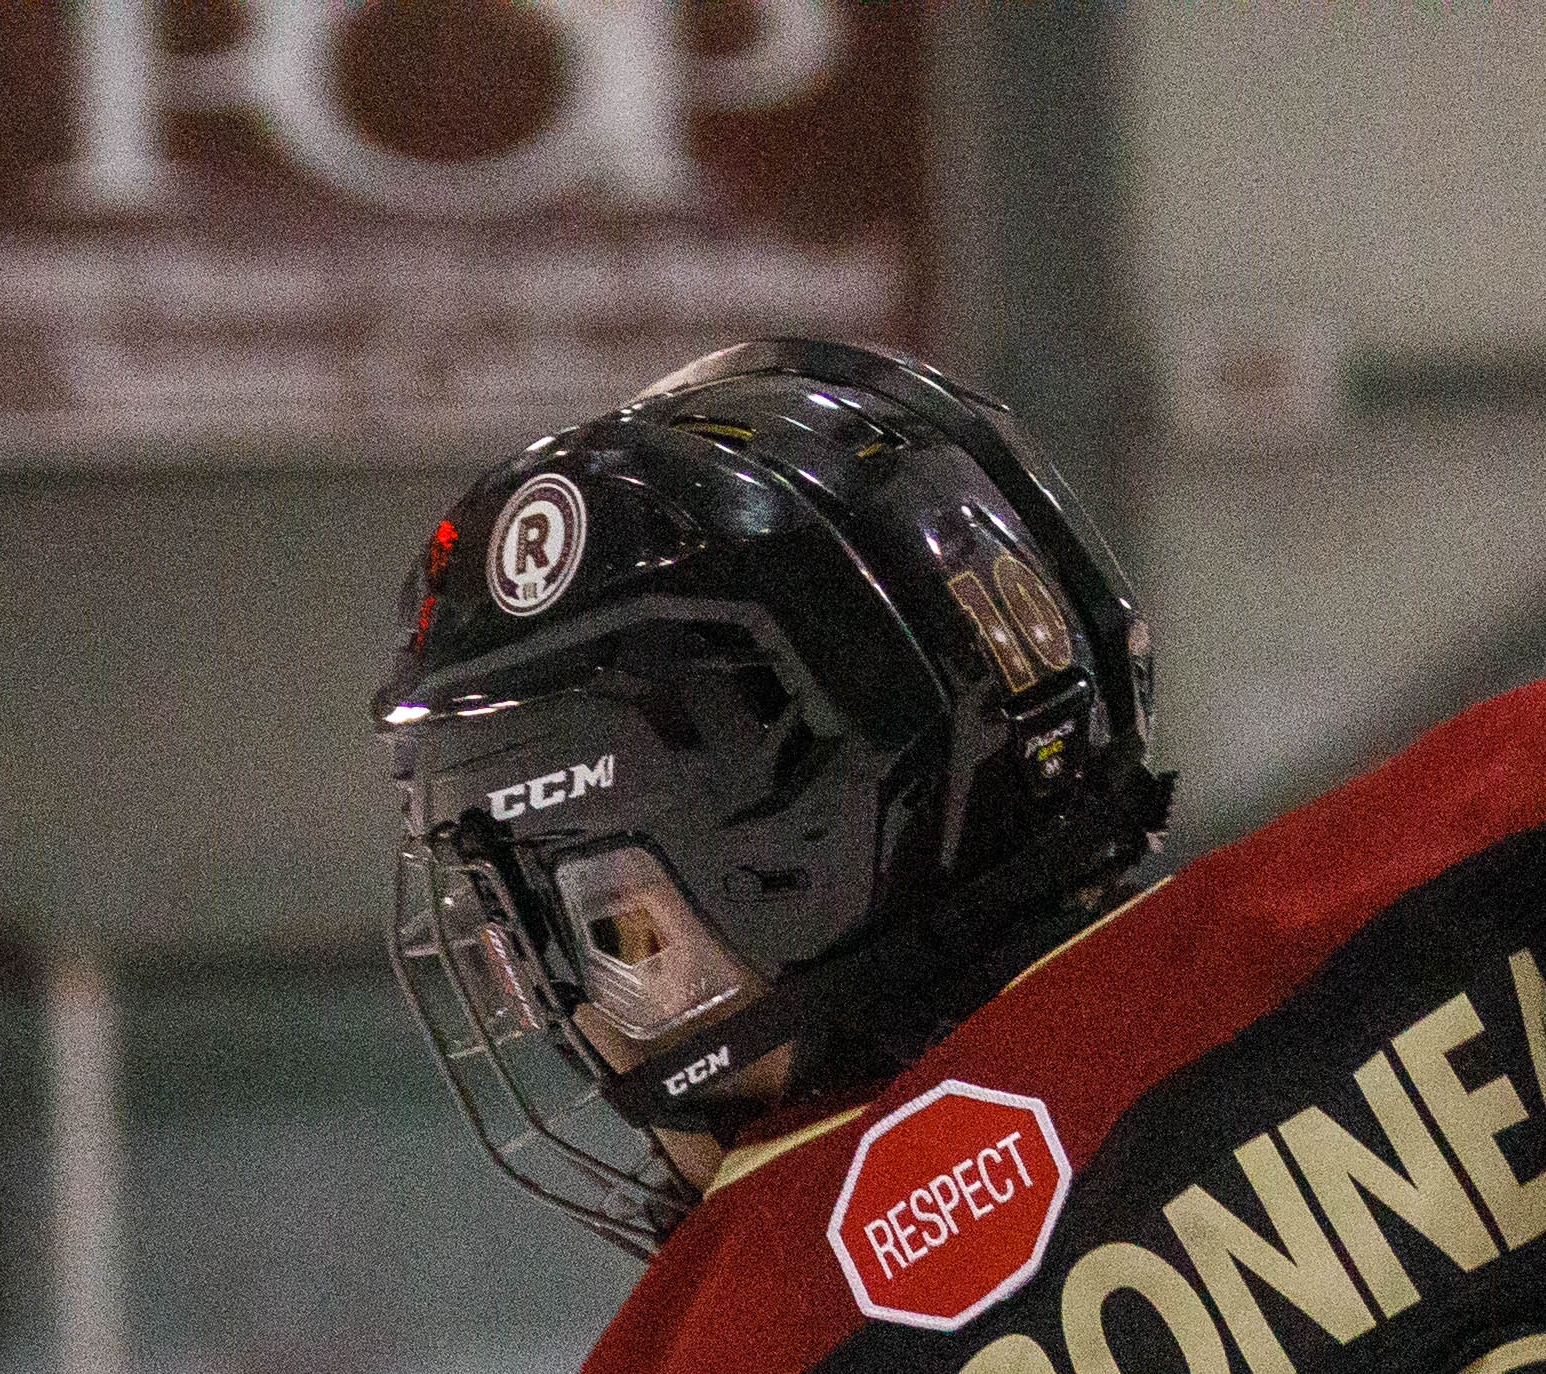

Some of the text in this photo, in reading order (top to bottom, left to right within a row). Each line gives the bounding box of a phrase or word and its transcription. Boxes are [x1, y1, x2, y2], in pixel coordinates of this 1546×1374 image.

[947, 554, 1072, 693] 10
[486, 754, 614, 821] CCM
[663, 1045, 731, 1096] CCM
[864, 1131, 1034, 1281] RESPECT
